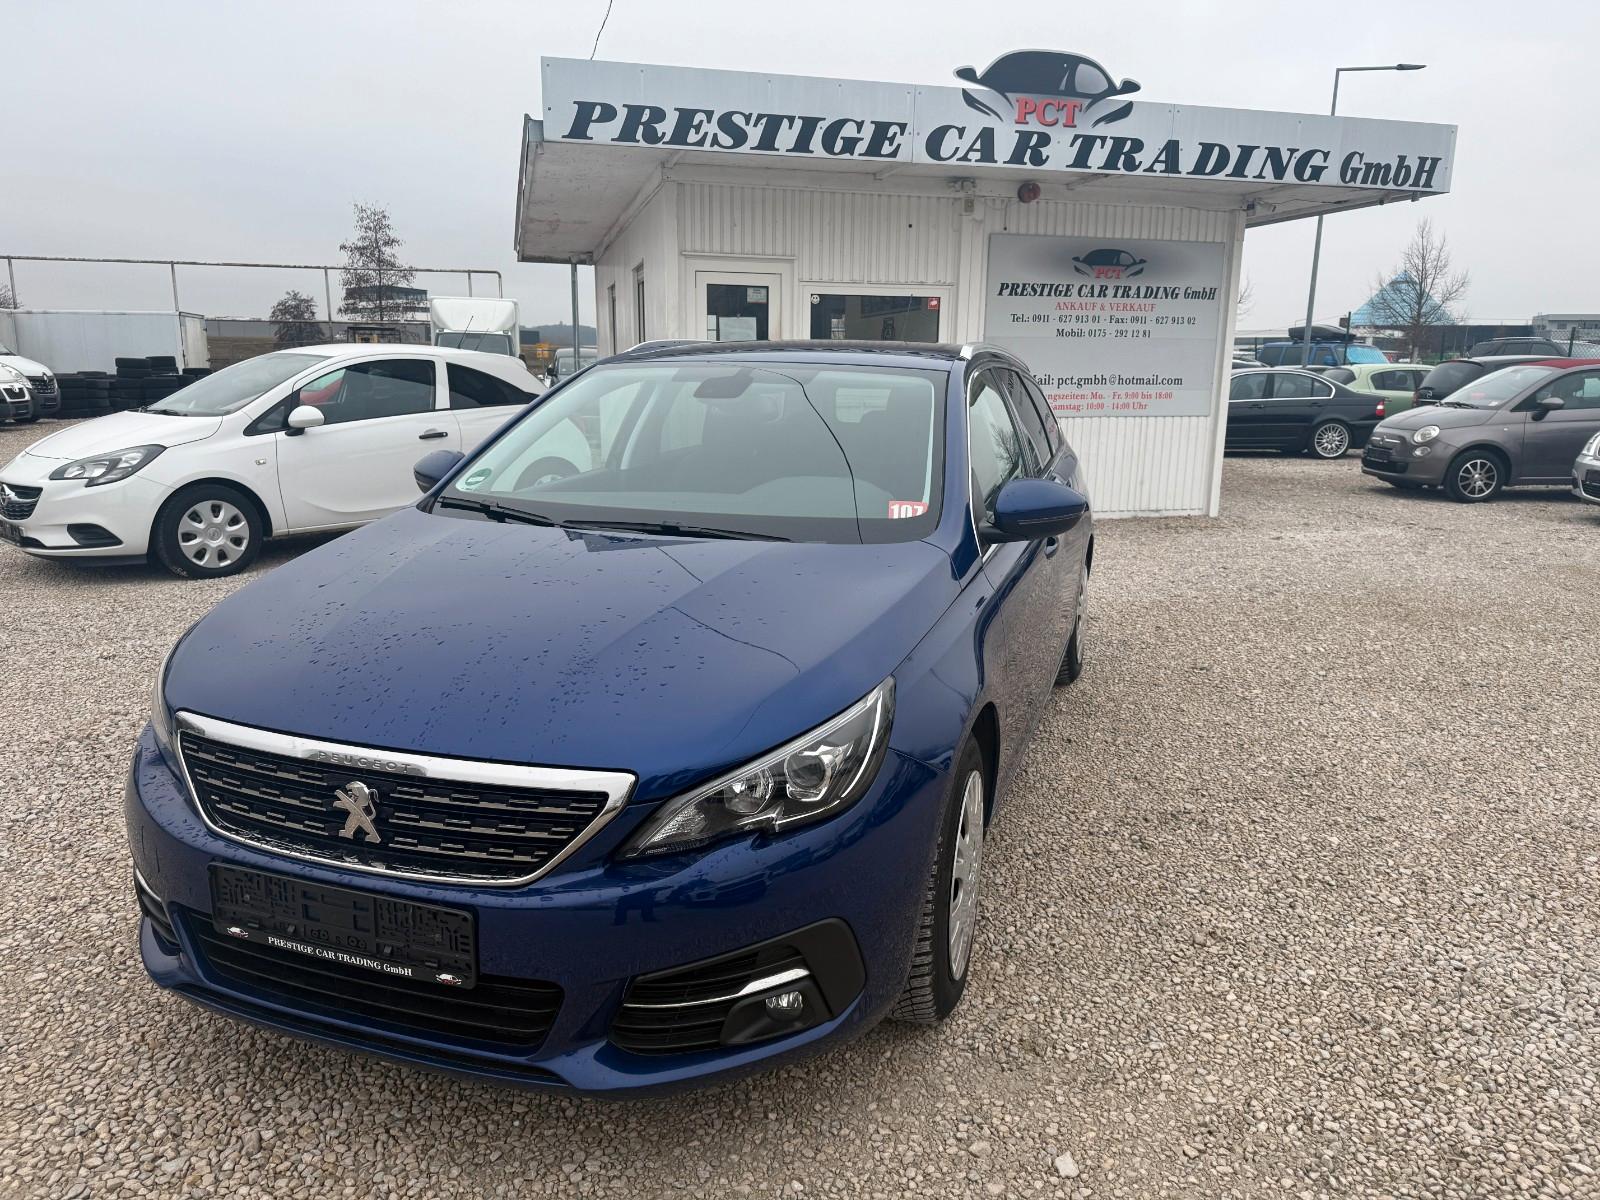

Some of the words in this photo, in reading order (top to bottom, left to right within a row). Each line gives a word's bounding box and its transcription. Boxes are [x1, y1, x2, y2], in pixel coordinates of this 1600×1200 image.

[1014, 96, 1083, 128] PCT
[561, 100, 908, 160] PRESTIGE
[924, 124, 1051, 167] CAR
[1065, 131, 1331, 184] TRADING
[1339, 149, 1444, 190] GmbH
[1095, 268, 1121, 279] PCT
[997, 283, 1074, 297] PRESTIGE
[1078, 284, 1108, 298] CAR
[1112, 285, 1180, 300] TRADING
[1184, 286, 1218, 300] GmbH
[1055, 302, 1098, 311] ANKAUF
[1100, 303, 1106, 311] &
[1109, 303, 1157, 312] VERKAUF
[1011, 314, 1030, 323] Tel.:
[1032, 314, 1050, 323] 0911
[1058, 315, 1073, 323] 627
[1075, 315, 1089, 323] 913
[1092, 315, 1101, 323] 01
[1109, 315, 1128, 324] Fax:
[1130, 316, 1147, 324] 0911
[1155, 316, 1169, 325] 627
[1171, 316, 1185, 325] 913
[1187, 316, 1196, 325] 02
[1056, 328, 1086, 337] Mobil:
[1088, 329, 1106, 338] 0175
[1114, 329, 1128, 338] 292
[1131, 329, 1140, 338] 12
[1142, 329, 1151, 338] 81
[1057, 374, 1183, 389] pct.gmbh@hotmail.com
[1124, 392, 1139, 400] 9:00
[1141, 392, 1152, 400] bis
[1155, 392, 1173, 400] 18:00
[1132, 402, 1148, 410] Uhr
[317, 751, 410, 773] PEUGEOT
[267, 936, 314, 955] PRESTIGE
[316, 948, 336, 960] CAR
[337, 953, 381, 970] TRADING
[383, 963, 413, 977] GmbH
